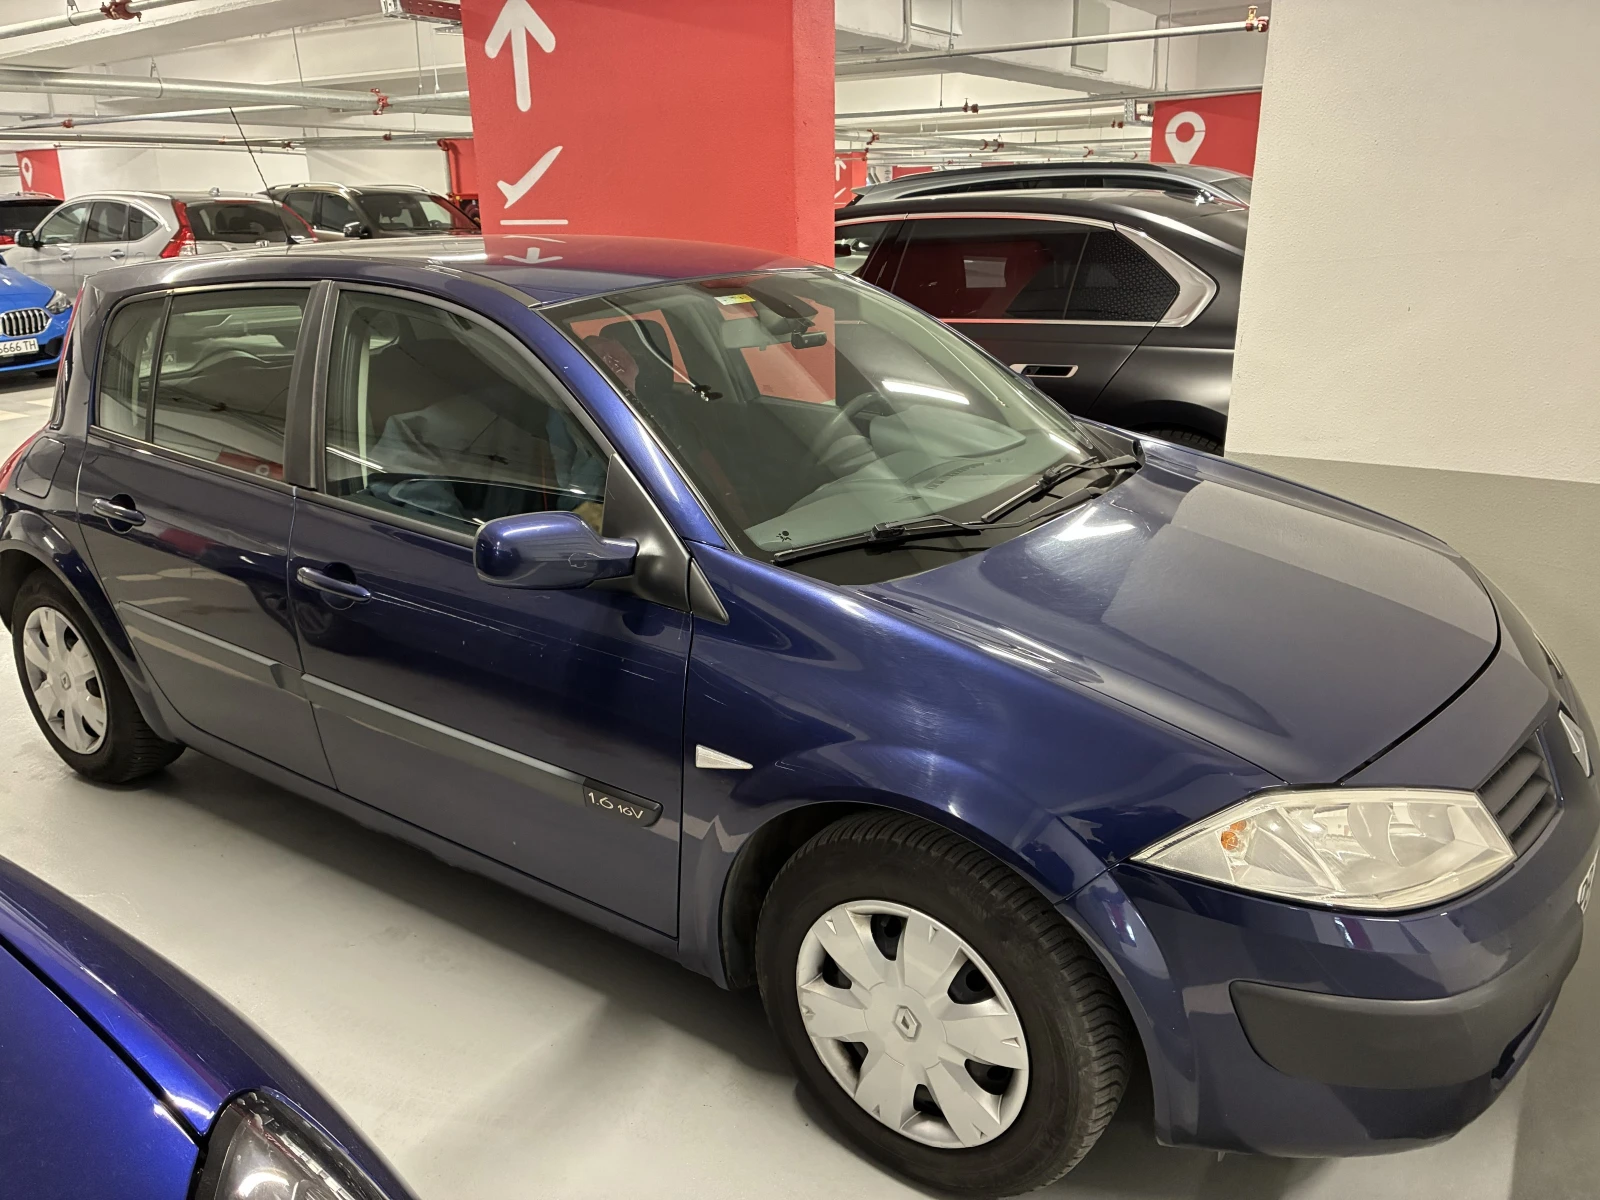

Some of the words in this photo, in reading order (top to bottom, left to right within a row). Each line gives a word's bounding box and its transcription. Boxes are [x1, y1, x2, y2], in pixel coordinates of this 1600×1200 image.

[23, 340, 37, 351] TH
[588, 792, 614, 809] 1.6
[617, 804, 644, 819] 16V
